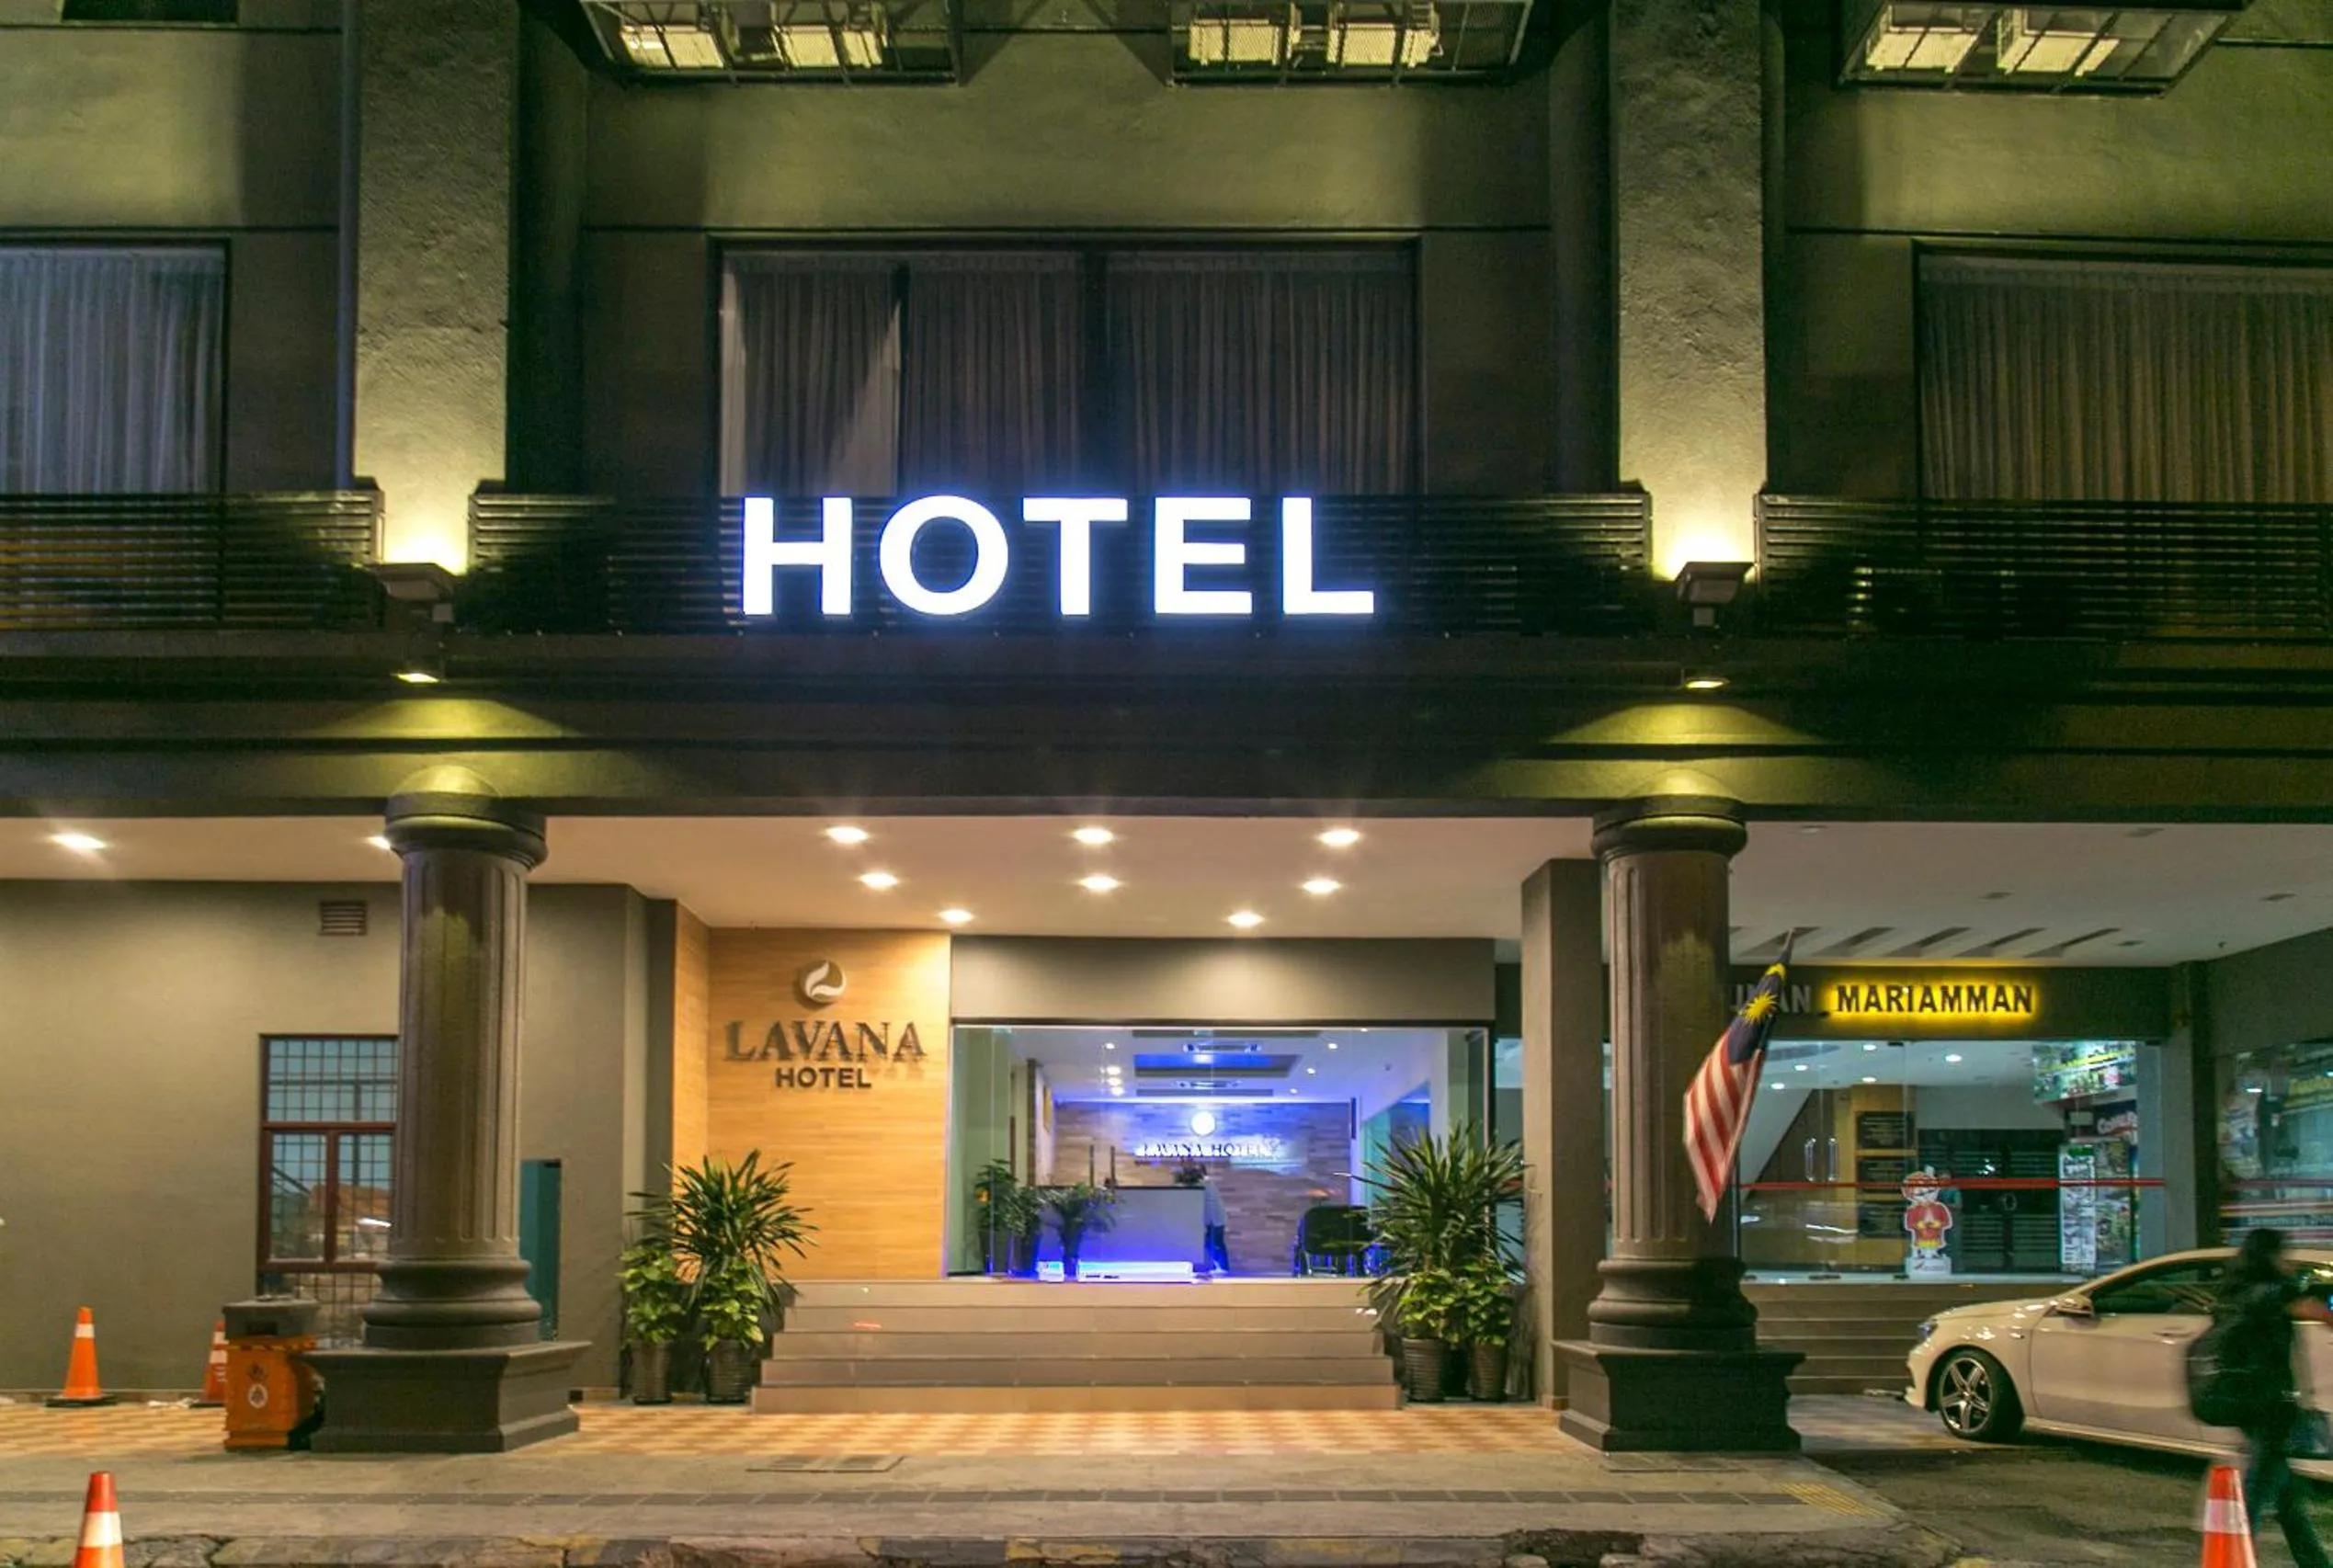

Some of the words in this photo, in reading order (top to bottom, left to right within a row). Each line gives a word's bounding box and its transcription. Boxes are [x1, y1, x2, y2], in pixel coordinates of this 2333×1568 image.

[743, 494, 1374, 616] HOTEL
[1838, 983, 2032, 1014] MARIAMMAN
[724, 1019, 928, 1061] LAVANA
[776, 1067, 871, 1088] HOTEL
